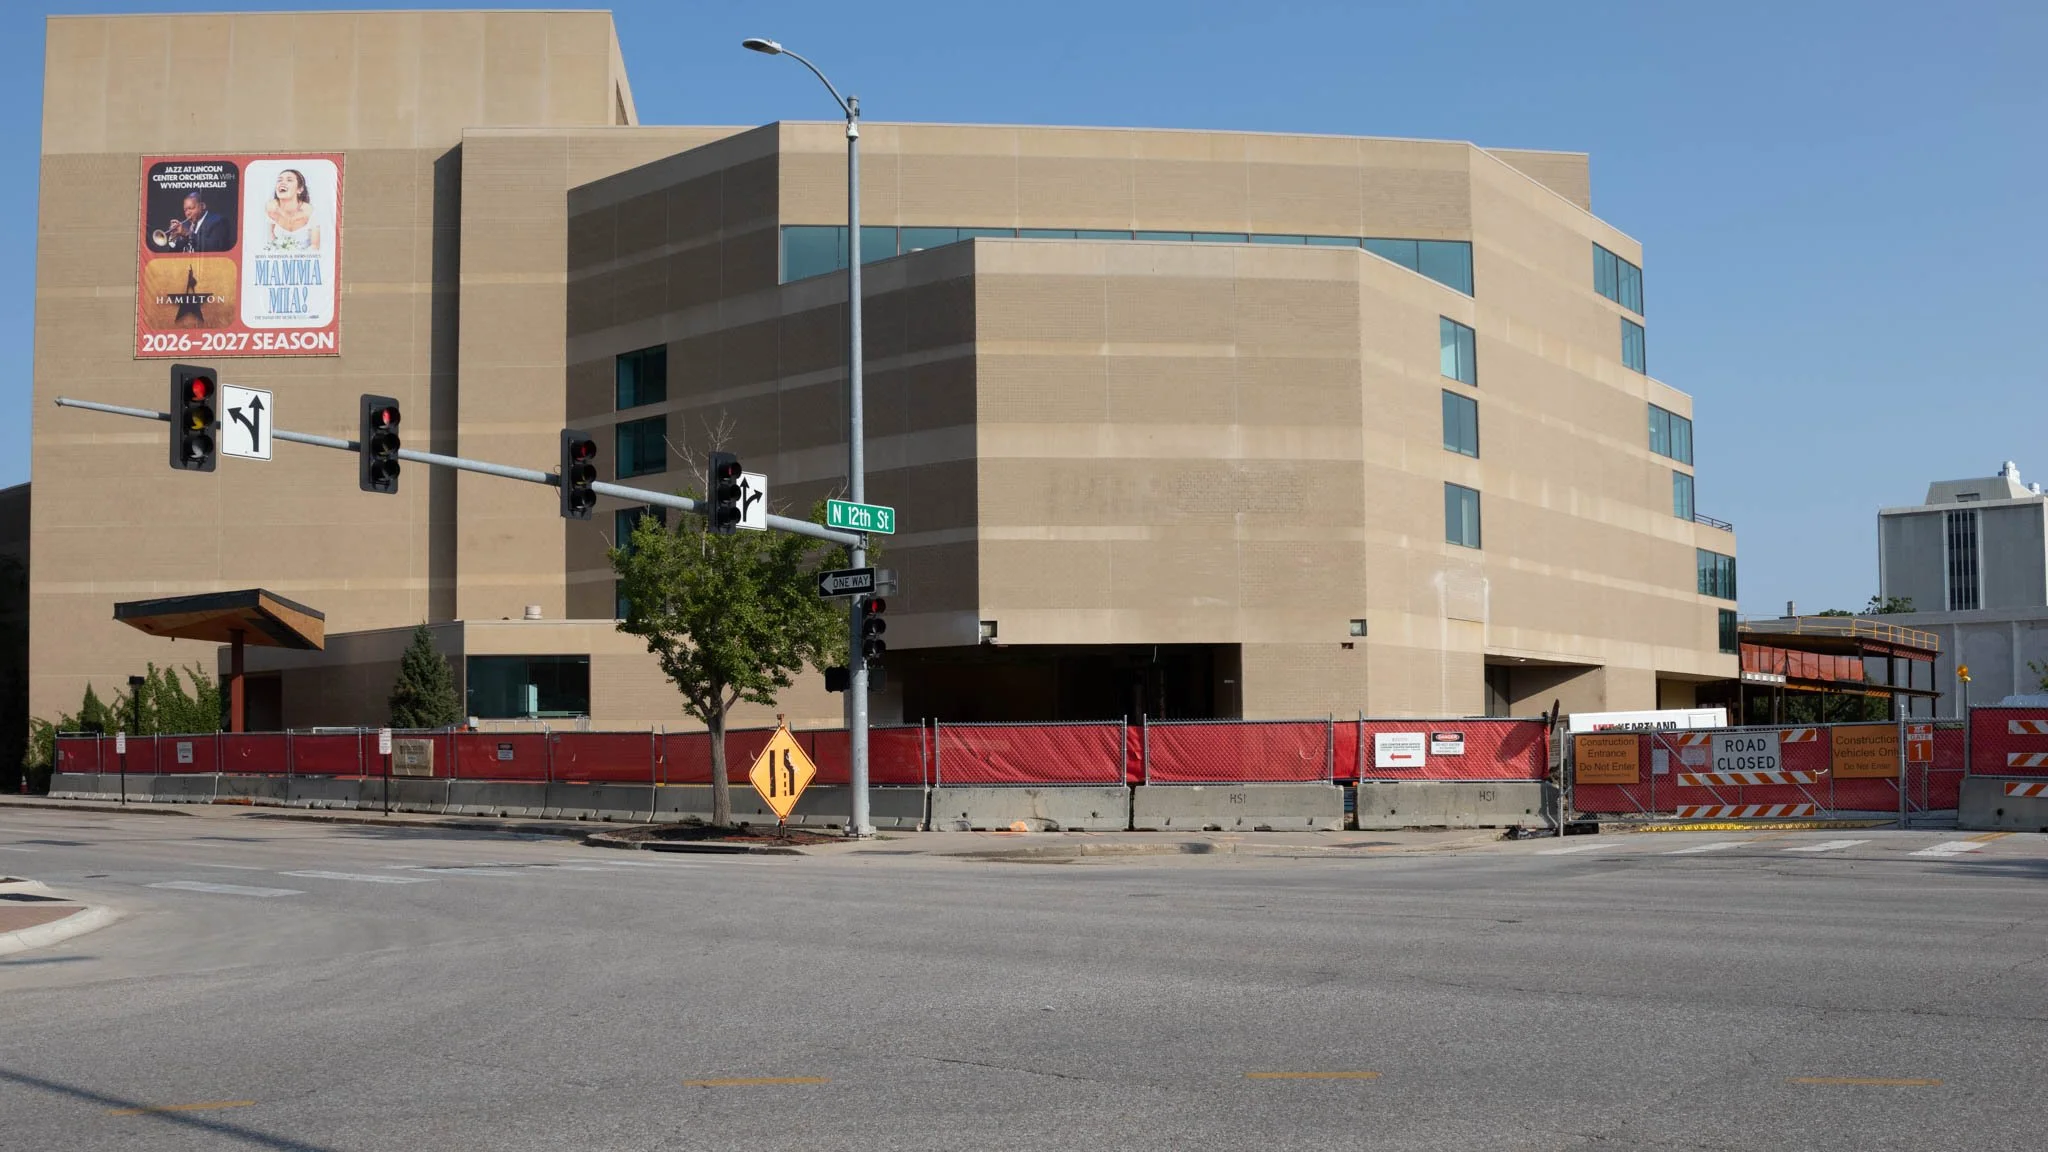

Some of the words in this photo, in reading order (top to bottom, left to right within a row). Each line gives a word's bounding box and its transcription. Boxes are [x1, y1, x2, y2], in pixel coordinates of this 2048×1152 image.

[192, 165, 223, 173] LINCOLN
[152, 174, 178, 182] CENTER
[179, 173, 219, 181] ORCHESTRA
[193, 181, 227, 189] MARSALIS
[255, 259, 322, 286] MAMMA
[156, 295, 225, 304] HAMILTON
[268, 287, 308, 313] MIA!
[251, 332, 334, 350] SEASON
[833, 504, 842, 524] N
[848, 506, 871, 528] 12th
[877, 510, 889, 530] St
[833, 577, 851, 588] ONE
[852, 575, 869, 587] WAY
[1580, 738, 1634, 747] Construction
[1725, 738, 1766, 752] ROAD
[1836, 735, 1900, 745] Construction
[1588, 749, 1627, 758] Entrance
[1834, 747, 1875, 758] Vehicles
[1915, 743, 1922, 760] 1
[1580, 762, 1592, 771] Do
[1595, 762, 1609, 771] Not
[1612, 761, 1636, 771] Enter
[1717, 755, 1776, 770] CLOSED
